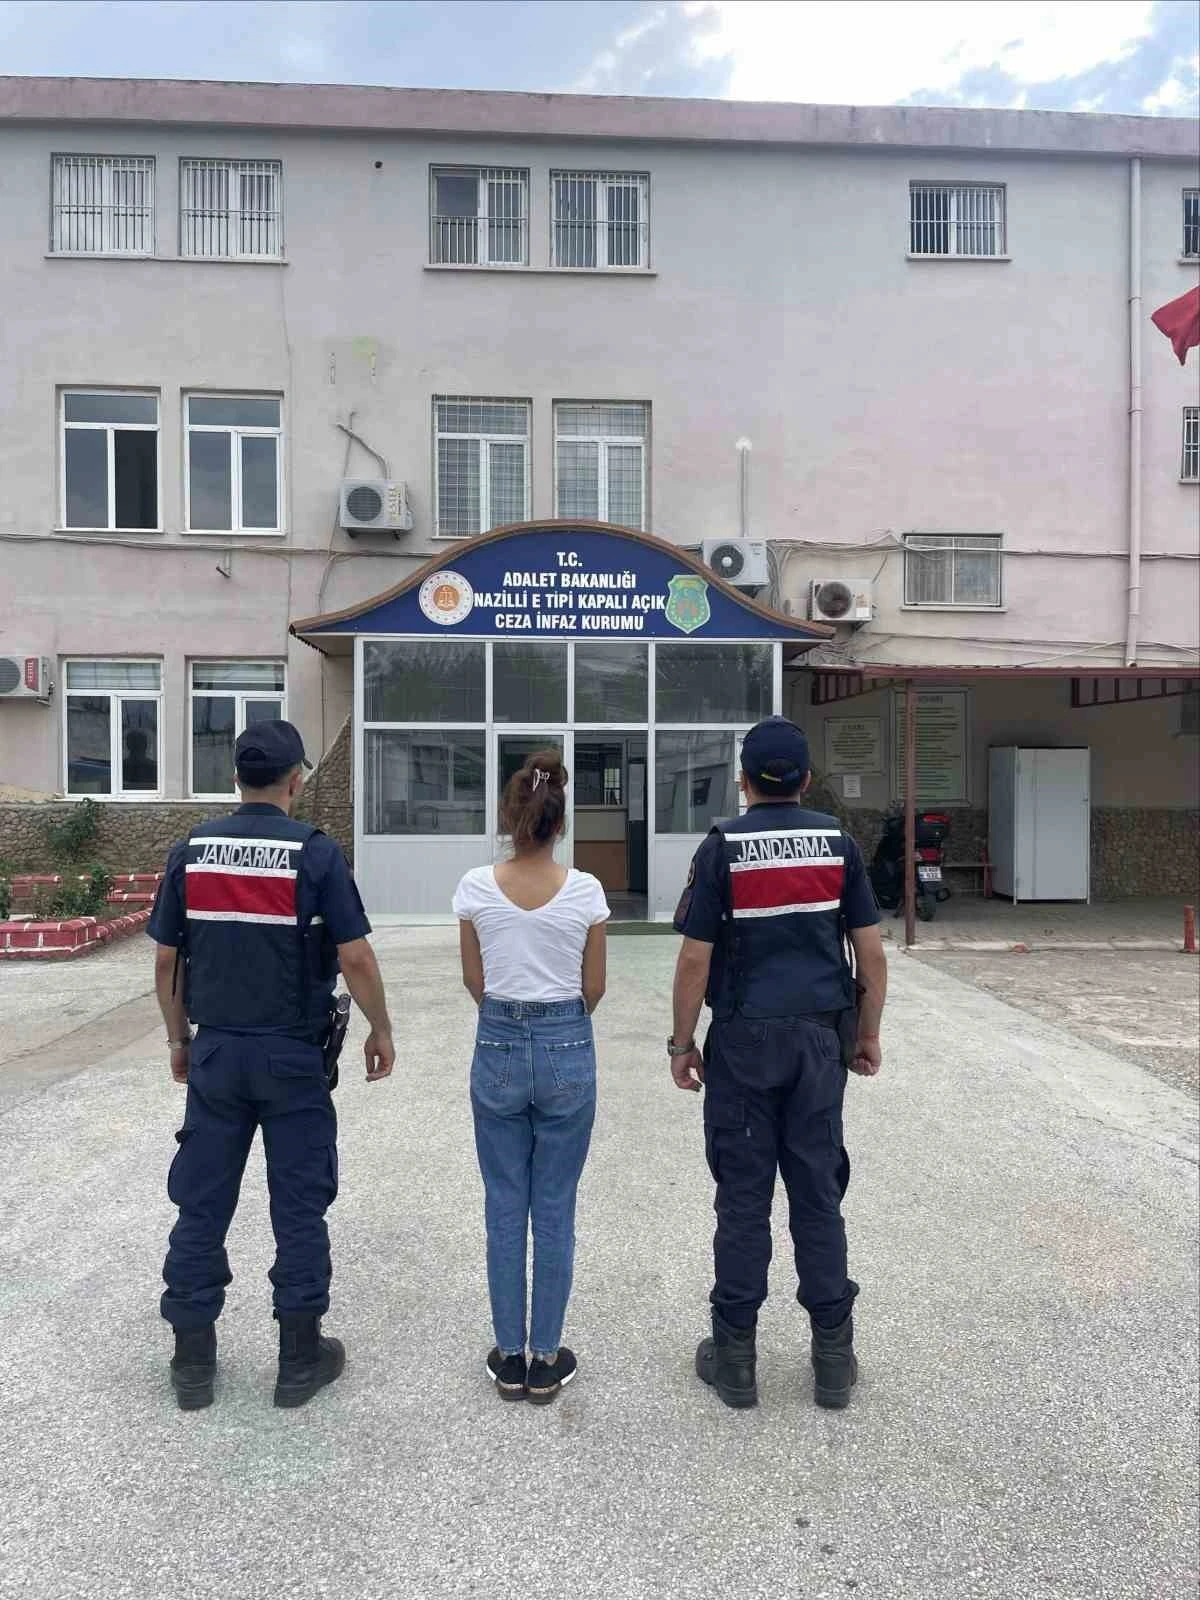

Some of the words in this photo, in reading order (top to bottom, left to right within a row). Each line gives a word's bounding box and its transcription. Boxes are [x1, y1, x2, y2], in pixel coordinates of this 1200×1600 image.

[557, 552, 583, 567] T.C.
[502, 572, 557, 588] ADALET
[561, 570, 637, 589] BAKANLIĞI
[474, 591, 528, 609] NAZİLLİ
[532, 594, 541, 608] E
[546, 592, 574, 609] TİPİ
[578, 594, 627, 610] KAPALI
[631, 595, 666, 615] AÇIK
[495, 613, 532, 629] CEZA
[536, 610, 577, 630] İNFAZ
[581, 614, 644, 631] KURUMU
[196, 843, 290, 869] JANDARMA
[737, 836, 833, 862] JANDARMA
